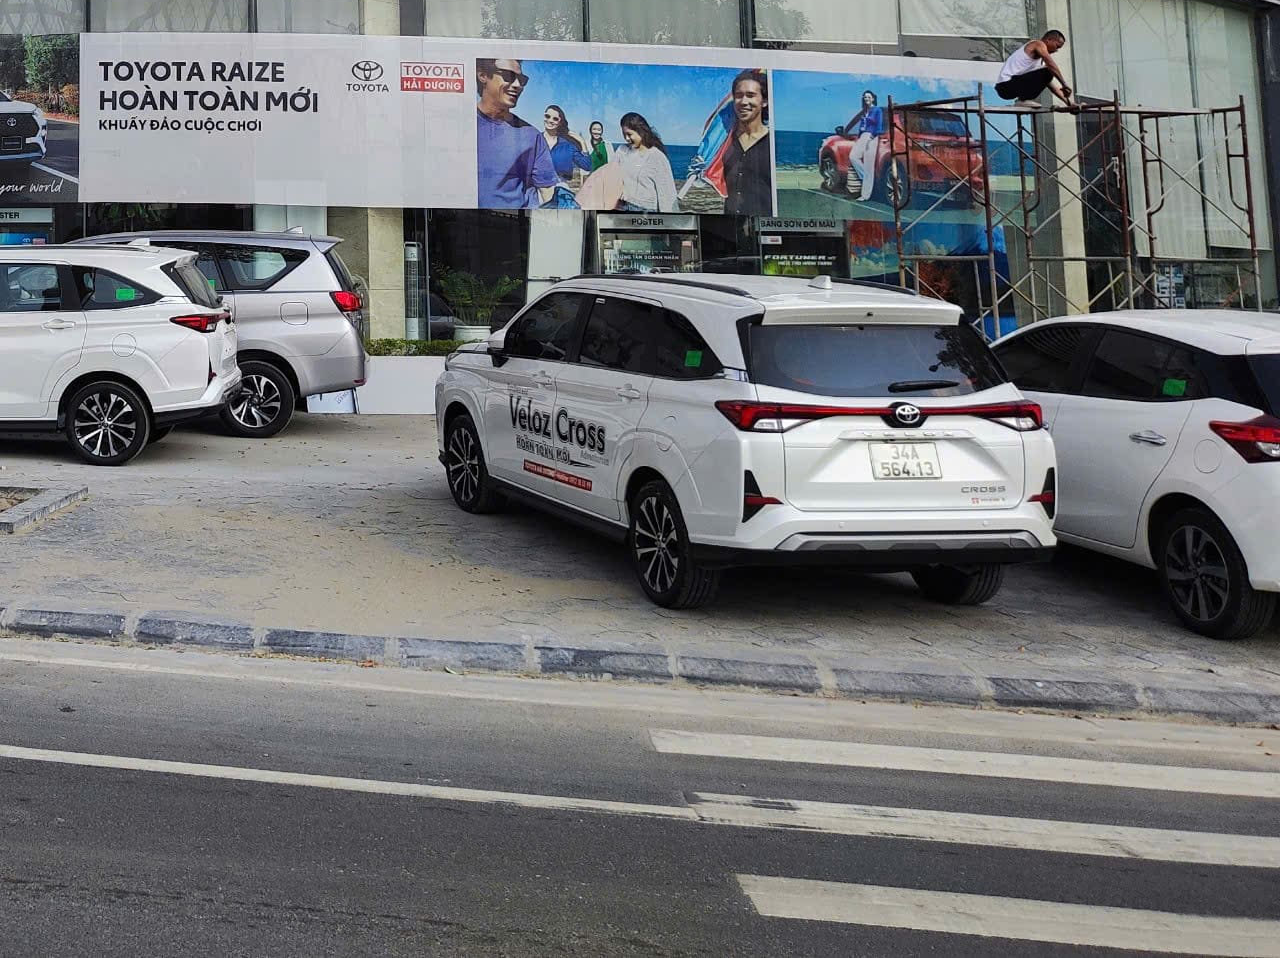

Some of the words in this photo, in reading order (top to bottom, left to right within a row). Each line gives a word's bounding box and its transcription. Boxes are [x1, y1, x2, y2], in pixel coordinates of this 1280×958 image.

[99, 61, 205, 82] TOYOTA
[211, 62, 285, 83] RAIZE
[403, 65, 461, 77] TOYOTA
[346, 83, 390, 93] TOYOTA
[403, 78, 422, 89] HẢI
[99, 85, 178, 111] HOÀN
[183, 86, 259, 111] TOÀN
[265, 87, 319, 113] MỚI
[150, 117, 181, 131] ĐẢO
[184, 118, 224, 134] CUỘC
[227, 119, 262, 132] CHƠI
[29, 177, 64, 193] world
[631, 218, 664, 226] POSTER
[509, 394, 552, 439] Veloz
[556, 407, 607, 455] Cross
[891, 445, 920, 460] 34A
[880, 461, 935, 477] 564.13
[960, 485, 1007, 494] CROSS
